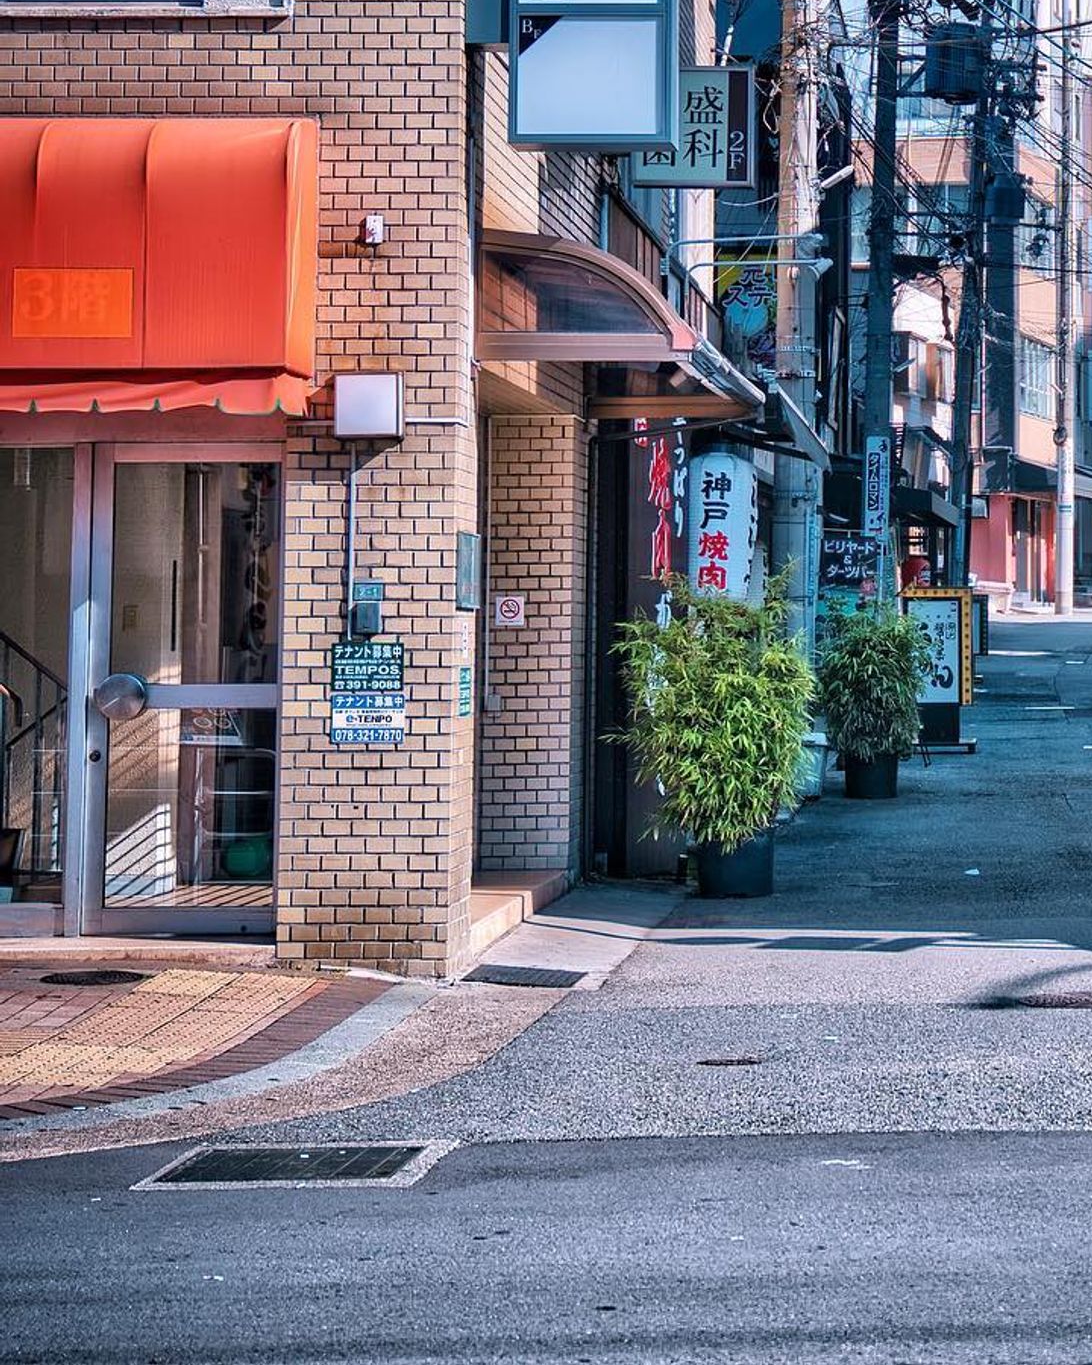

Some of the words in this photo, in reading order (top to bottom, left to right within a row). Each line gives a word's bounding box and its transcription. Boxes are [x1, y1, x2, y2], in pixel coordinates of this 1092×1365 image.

[722, 286, 777, 308] ステ
[698, 471, 732, 591] 神戸焼肉
[824, 540, 876, 554] ビリヤード
[827, 564, 878, 578] ダーツバー
[335, 645, 402, 658] テナント募集中
[346, 680, 400, 690] 391-9088
[336, 696, 403, 707] テナント募集中
